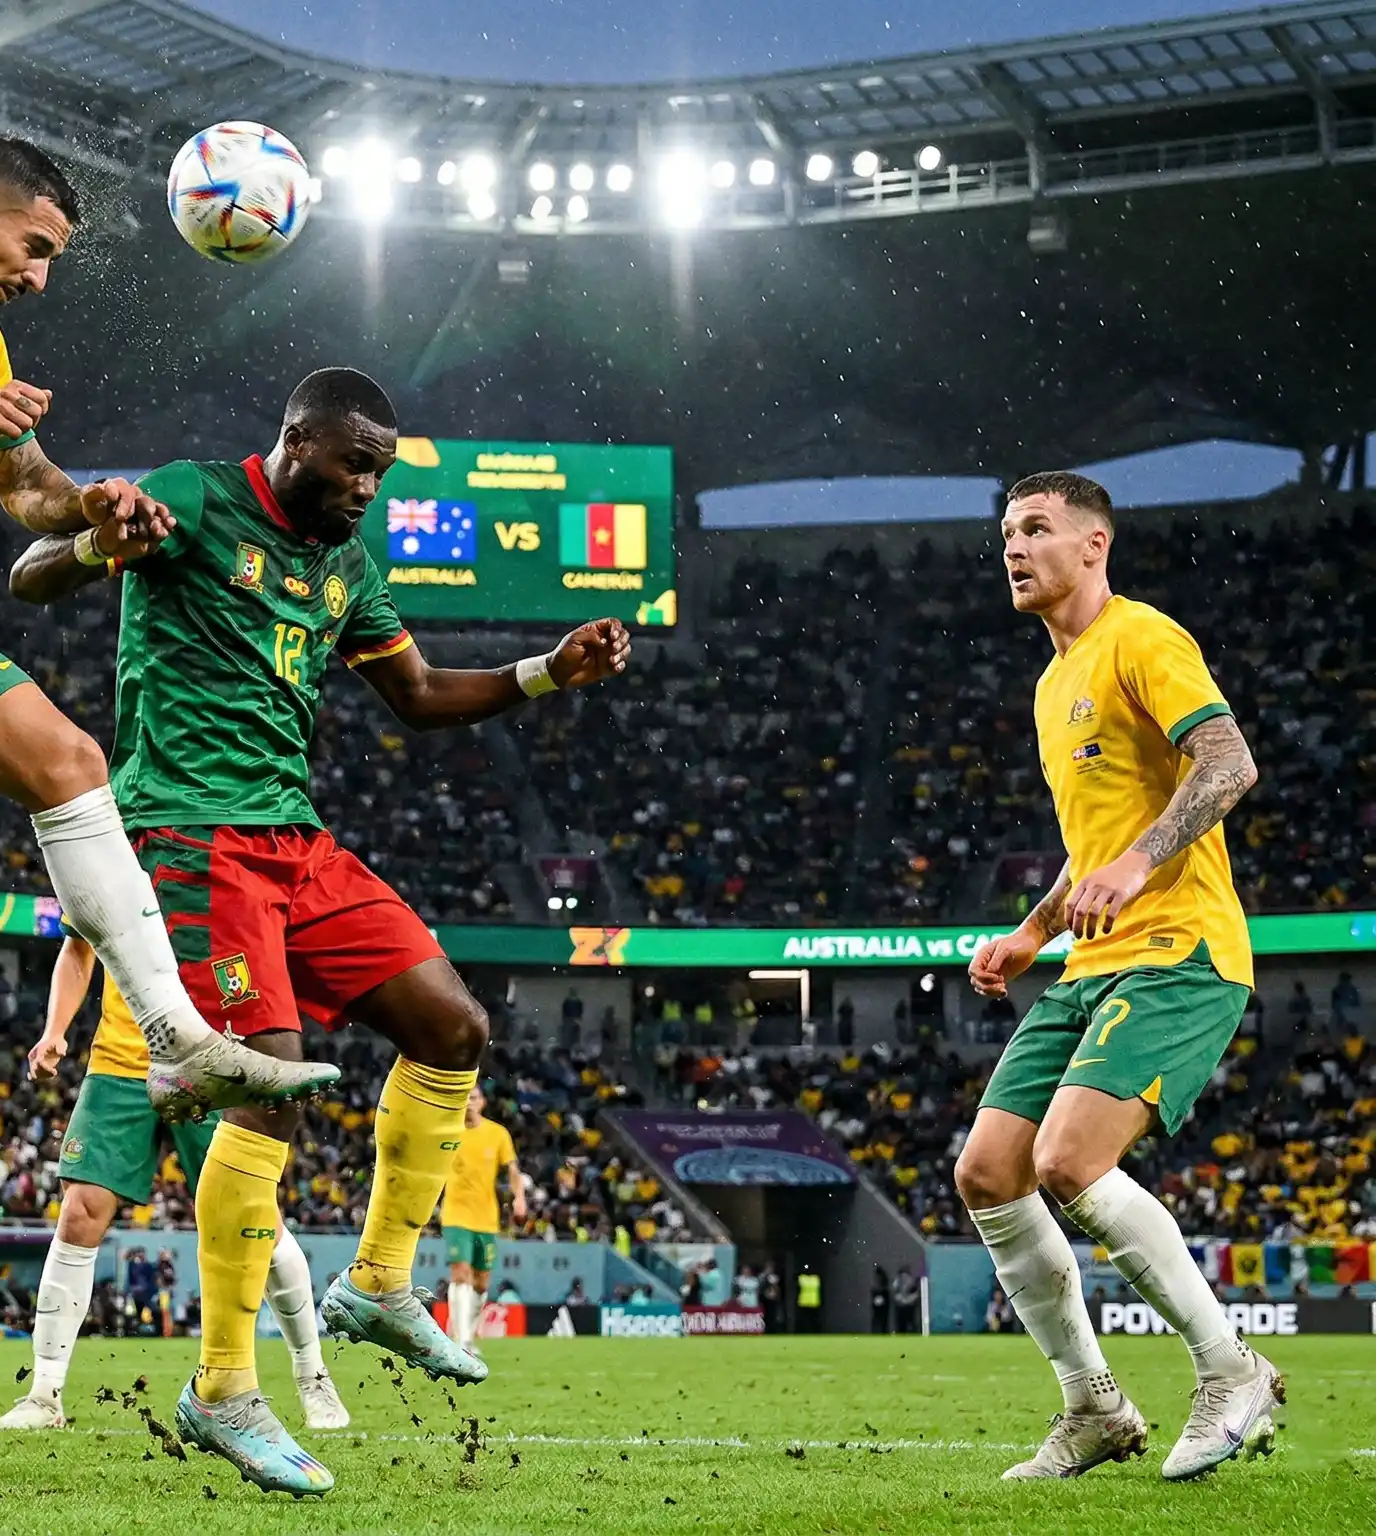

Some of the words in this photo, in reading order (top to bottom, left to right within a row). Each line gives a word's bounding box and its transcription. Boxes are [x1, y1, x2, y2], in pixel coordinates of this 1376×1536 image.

[494, 521, 541, 551] VS
[274, 623, 307, 686] 12
[783, 935, 924, 959] AUSTRALIA
